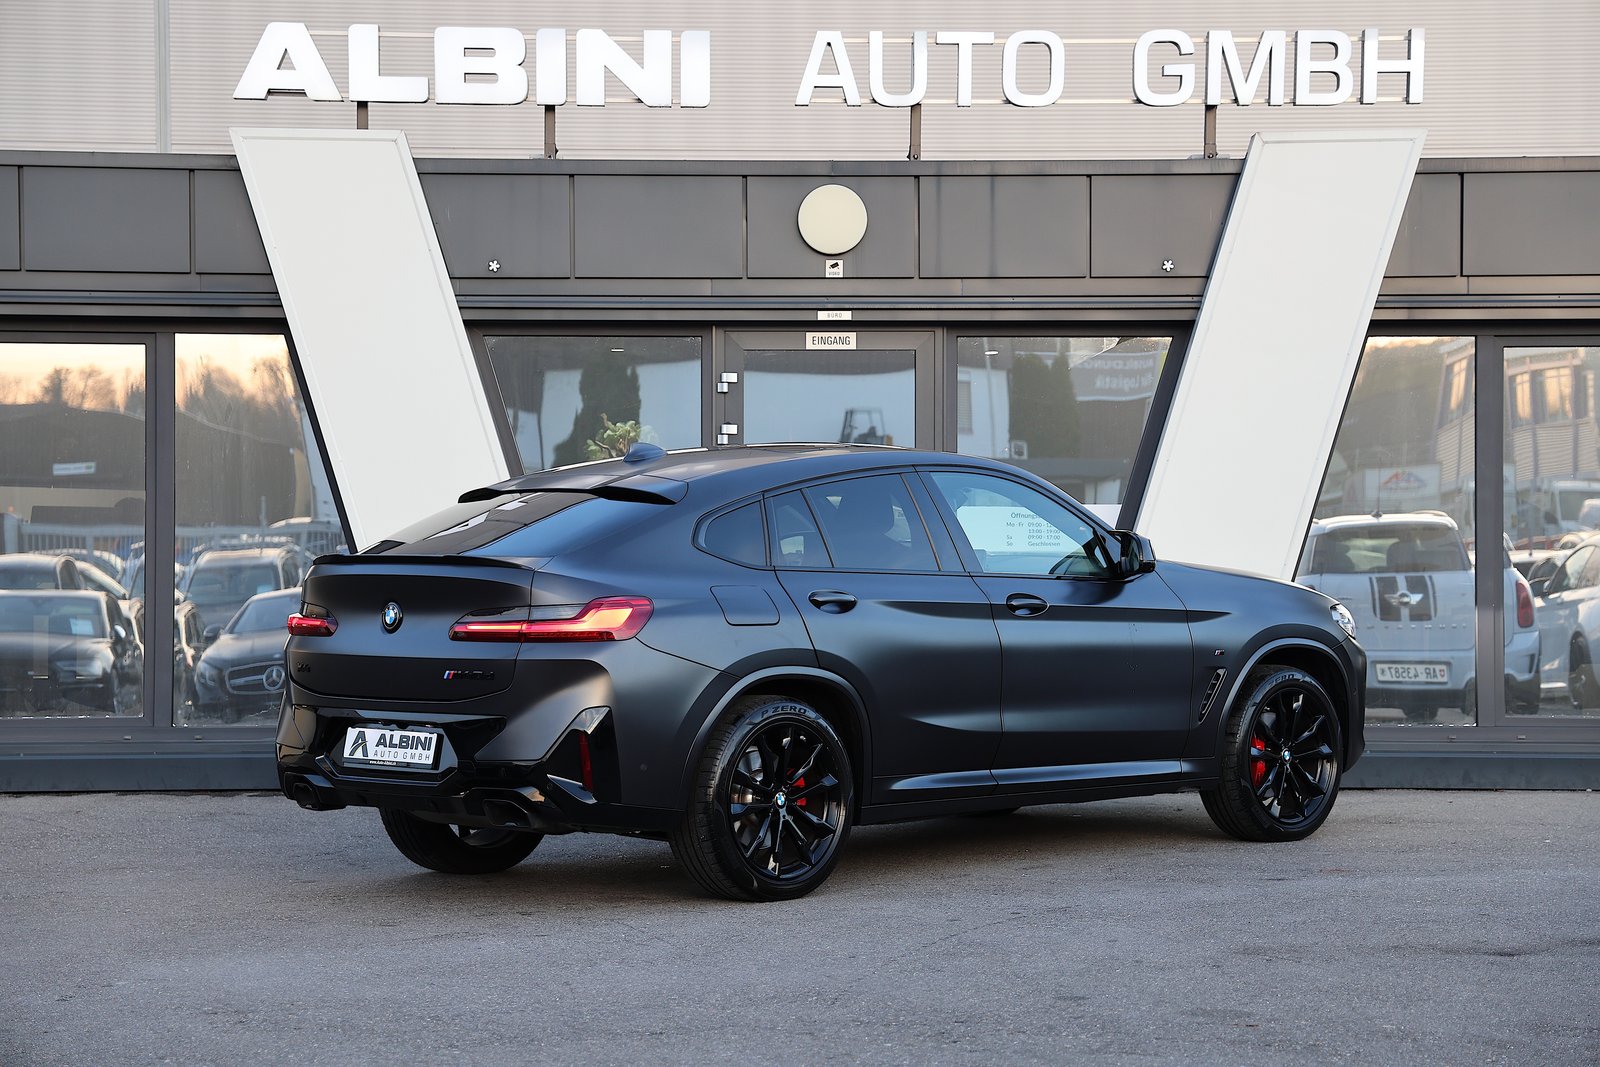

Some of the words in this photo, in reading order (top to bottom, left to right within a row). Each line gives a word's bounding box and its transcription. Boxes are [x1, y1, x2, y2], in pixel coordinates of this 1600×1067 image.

[233, 22, 710, 108] ALBINI
[794, 29, 1066, 108] AUTO
[1132, 28, 1426, 107] GMBH
[812, 335, 851, 346] EINGANG
[760, 709, 769, 719] P
[772, 704, 807, 715] ZERO
[375, 733, 433, 751] ALBINI
[373, 749, 399, 759] AUTO
[402, 751, 431, 761] GMBH
